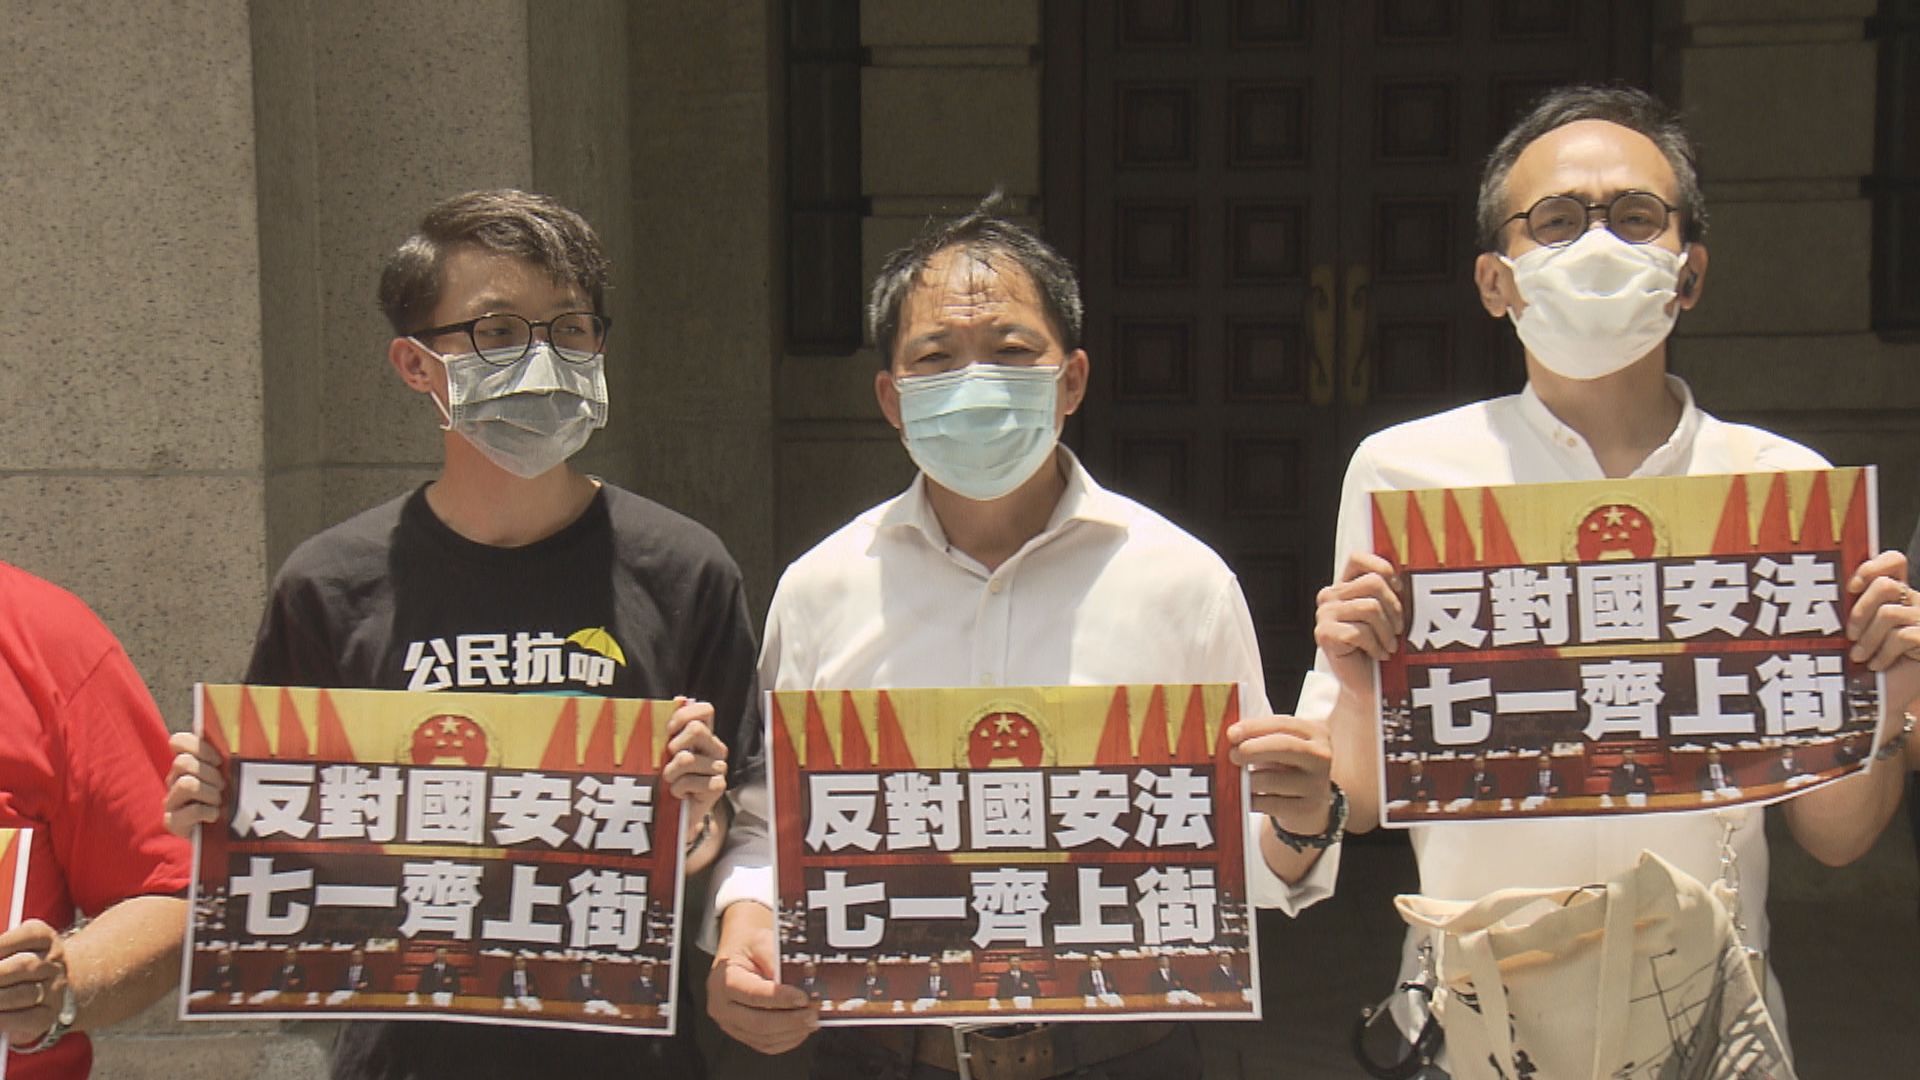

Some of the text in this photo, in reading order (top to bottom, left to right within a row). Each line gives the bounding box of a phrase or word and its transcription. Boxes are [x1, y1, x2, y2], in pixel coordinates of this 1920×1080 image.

[1408, 554, 1842, 650] 反對國安法
[1411, 653, 1845, 746] 七一齊上街
[231, 761, 654, 855] 反對國安法
[805, 767, 1214, 852] 反對國安法
[229, 857, 647, 951] 七一齊上街
[806, 866, 1217, 948] 七一齊上街
